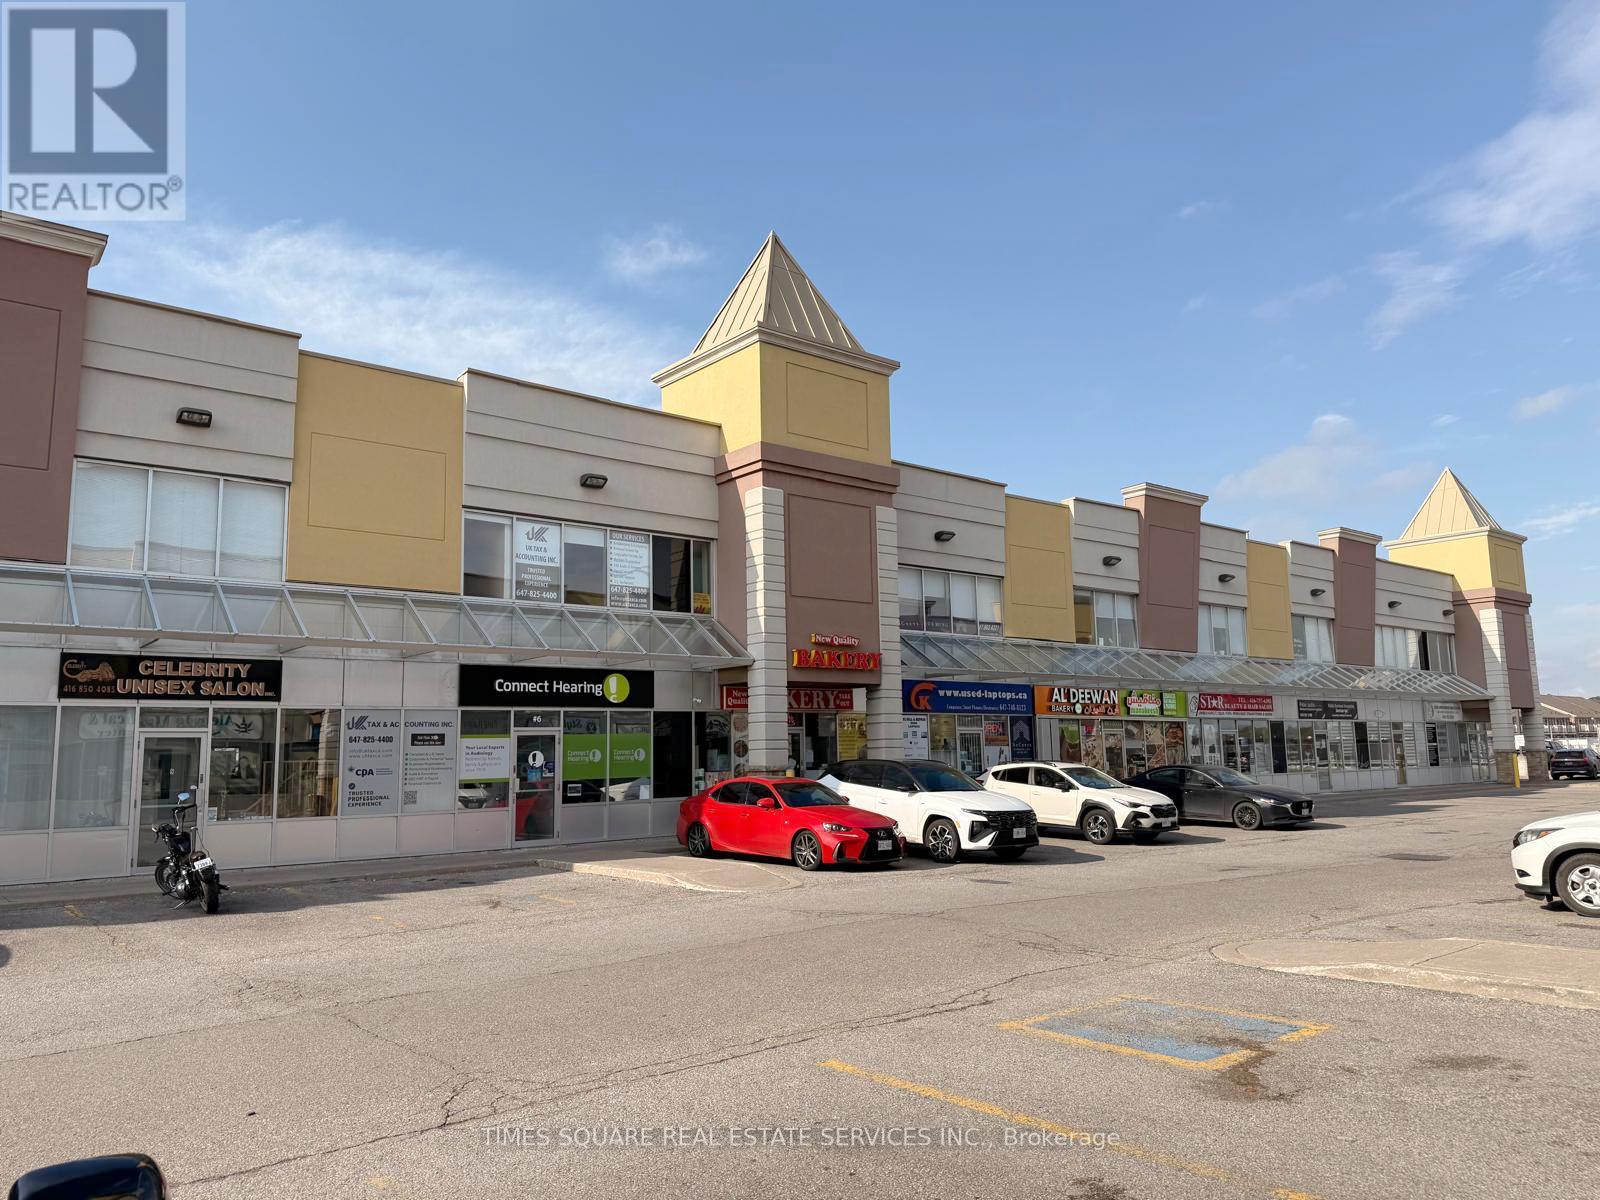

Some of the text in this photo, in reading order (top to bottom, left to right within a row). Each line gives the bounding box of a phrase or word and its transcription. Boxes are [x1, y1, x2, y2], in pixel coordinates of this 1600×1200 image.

[612, 532, 645, 542] OUR SERVICES
[516, 588, 558, 600] 647-825-4400
[610, 586, 648, 595] 647-825-4400
[813, 633, 860, 647] New Quality
[792, 649, 882, 670] BAKERY
[138, 660, 252, 678] CELEBRITY
[63, 684, 76, 693] 416
[117, 678, 196, 695] UNISEX
[200, 680, 265, 697] SALON
[494, 679, 603, 697] Connect Hearing
[732, 689, 748, 697] New
[787, 690, 839, 708] KERY
[938, 689, 1028, 700] www.used-laptops.ca
[1069, 688, 1119, 704] DEEWAN
[727, 697, 748, 706] Qualit
[1051, 705, 1074, 713] BAKERY
[532, 715, 542, 723] #6
[348, 735, 394, 744] 647-825-4400
